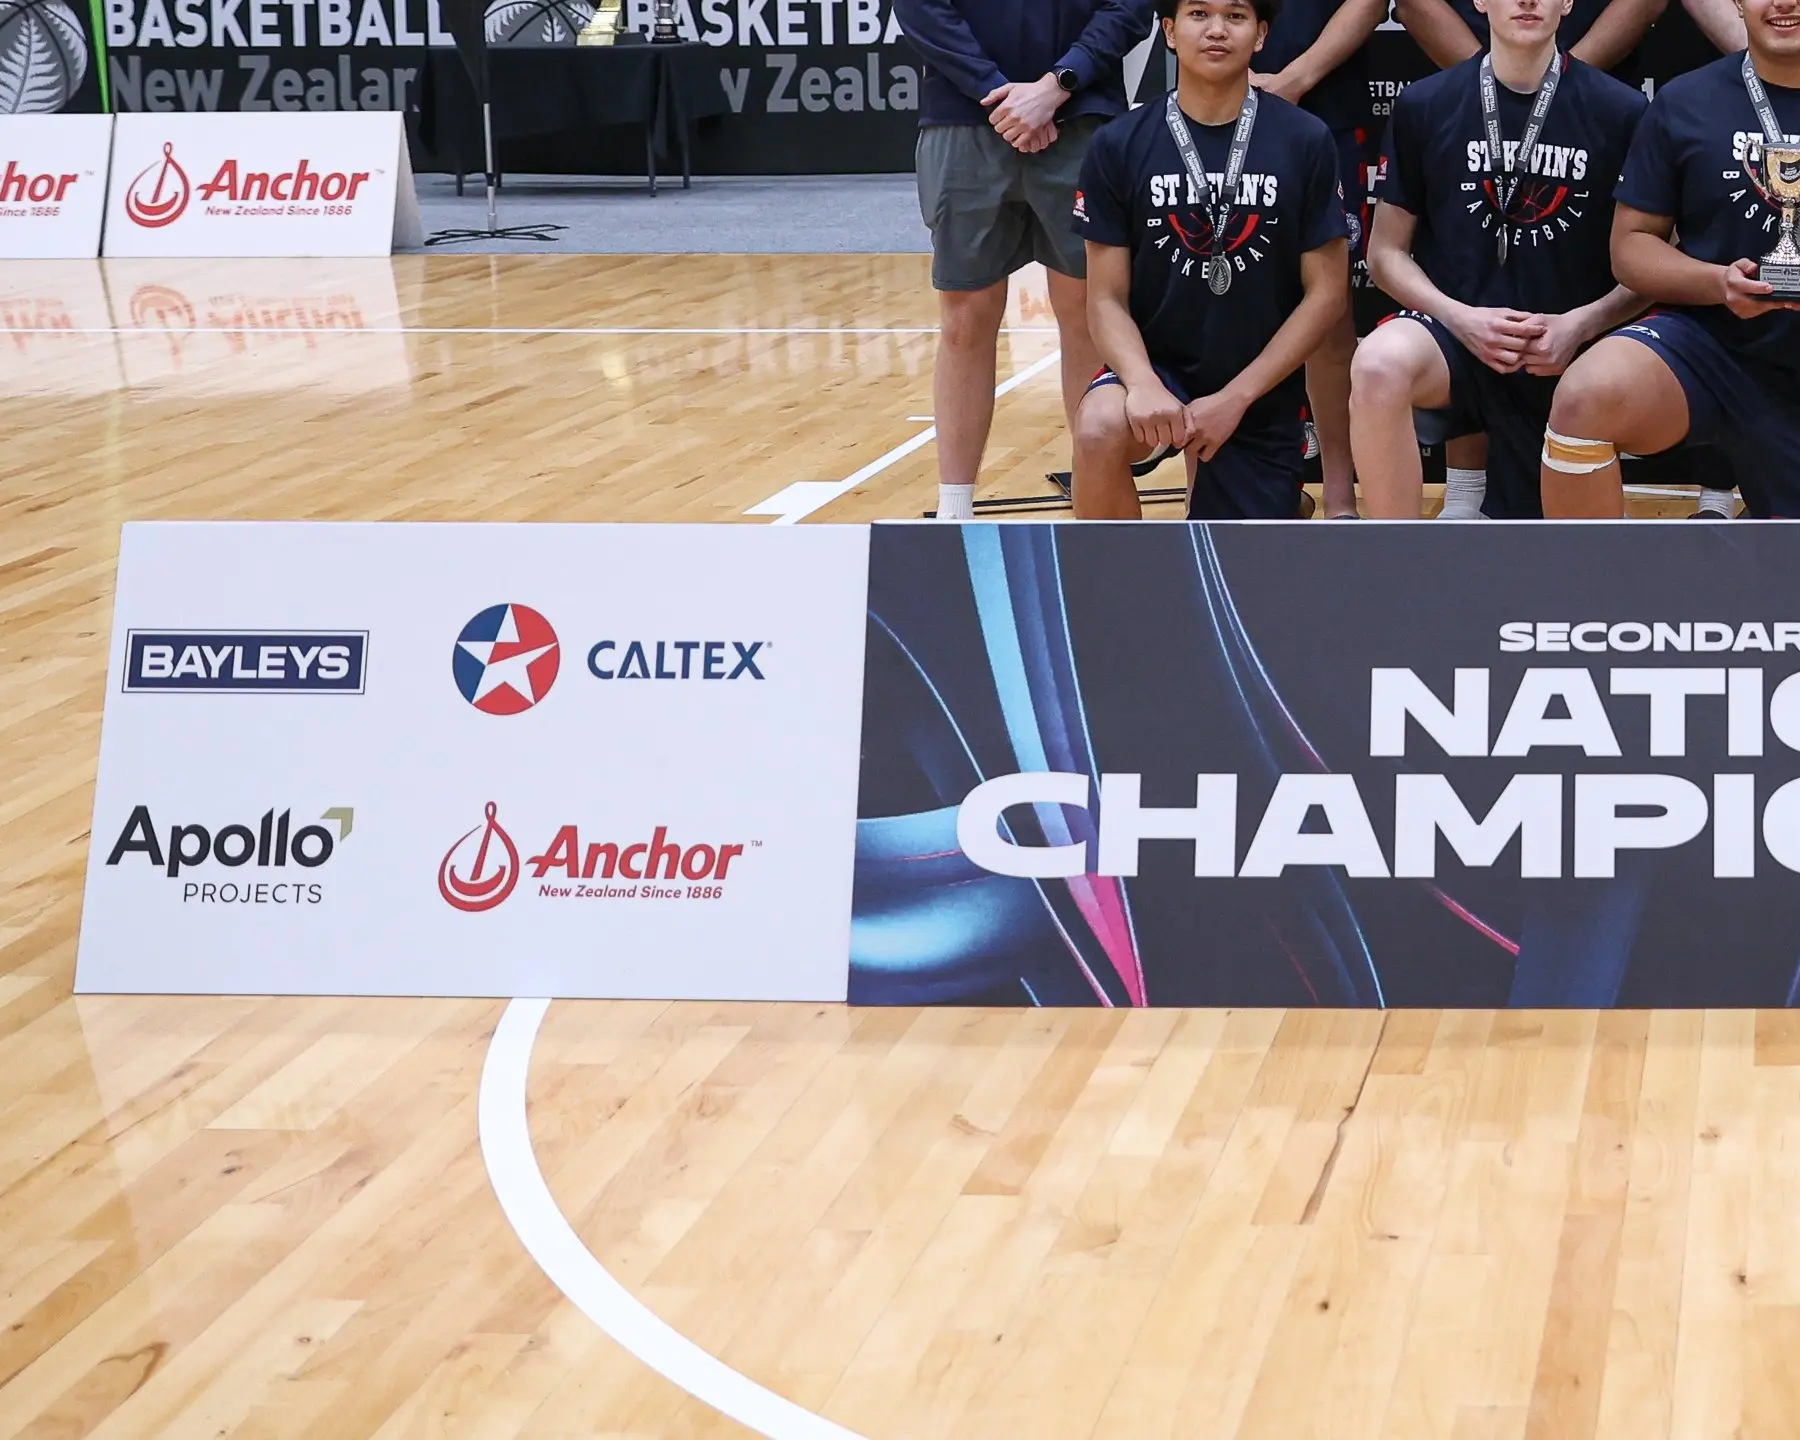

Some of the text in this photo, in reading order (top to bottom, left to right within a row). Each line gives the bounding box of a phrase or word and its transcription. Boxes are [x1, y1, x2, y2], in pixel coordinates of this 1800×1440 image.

[240, 55, 418, 112] Zeala
[766, 53, 918, 112] Zeala
[1502, 140, 1588, 180] KVIN'S
[197, 160, 369, 201] Anchor
[1150, 174, 1180, 207] ST
[205, 206, 352, 215] New Zealand Since 1886
[1461, 182, 1589, 247] BASETBALL
[141, 640, 765, 680] BAYLEYS CALTEX
[106, 805, 333, 877] Apollo
[526, 825, 742, 880] Anchor
[184, 883, 322, 904] PROJECTS
[539, 885, 723, 898] New Zealand Since 1886
